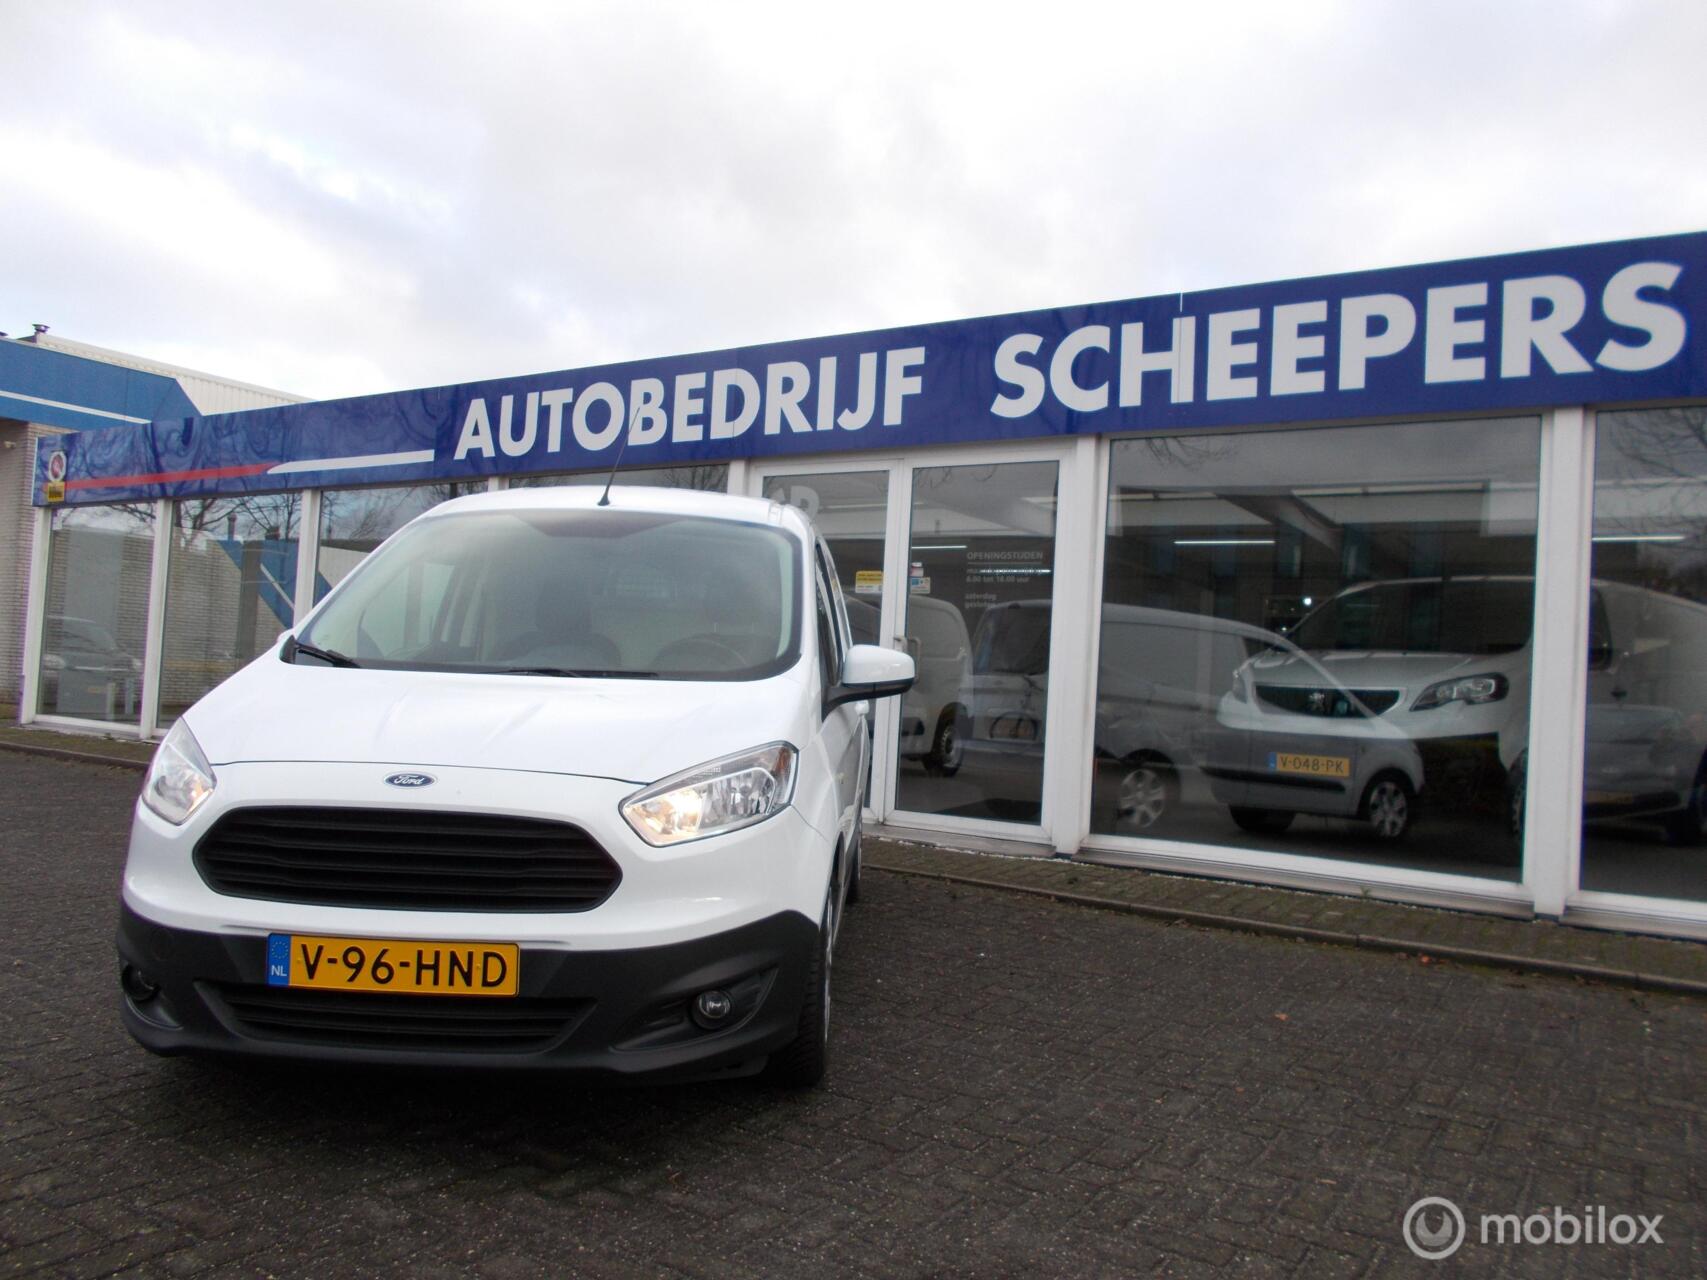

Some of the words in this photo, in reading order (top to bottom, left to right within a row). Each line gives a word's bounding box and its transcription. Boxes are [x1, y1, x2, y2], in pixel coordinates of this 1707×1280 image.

[454, 346, 926, 460] AUTOBEDRIJF
[990, 262, 1687, 418] SCHEEPERS
[1280, 756, 1344, 773] V-048-PK
[393, 775, 425, 785] Ford
[271, 965, 287, 976] NL
[301, 944, 507, 987] V-96-HND
